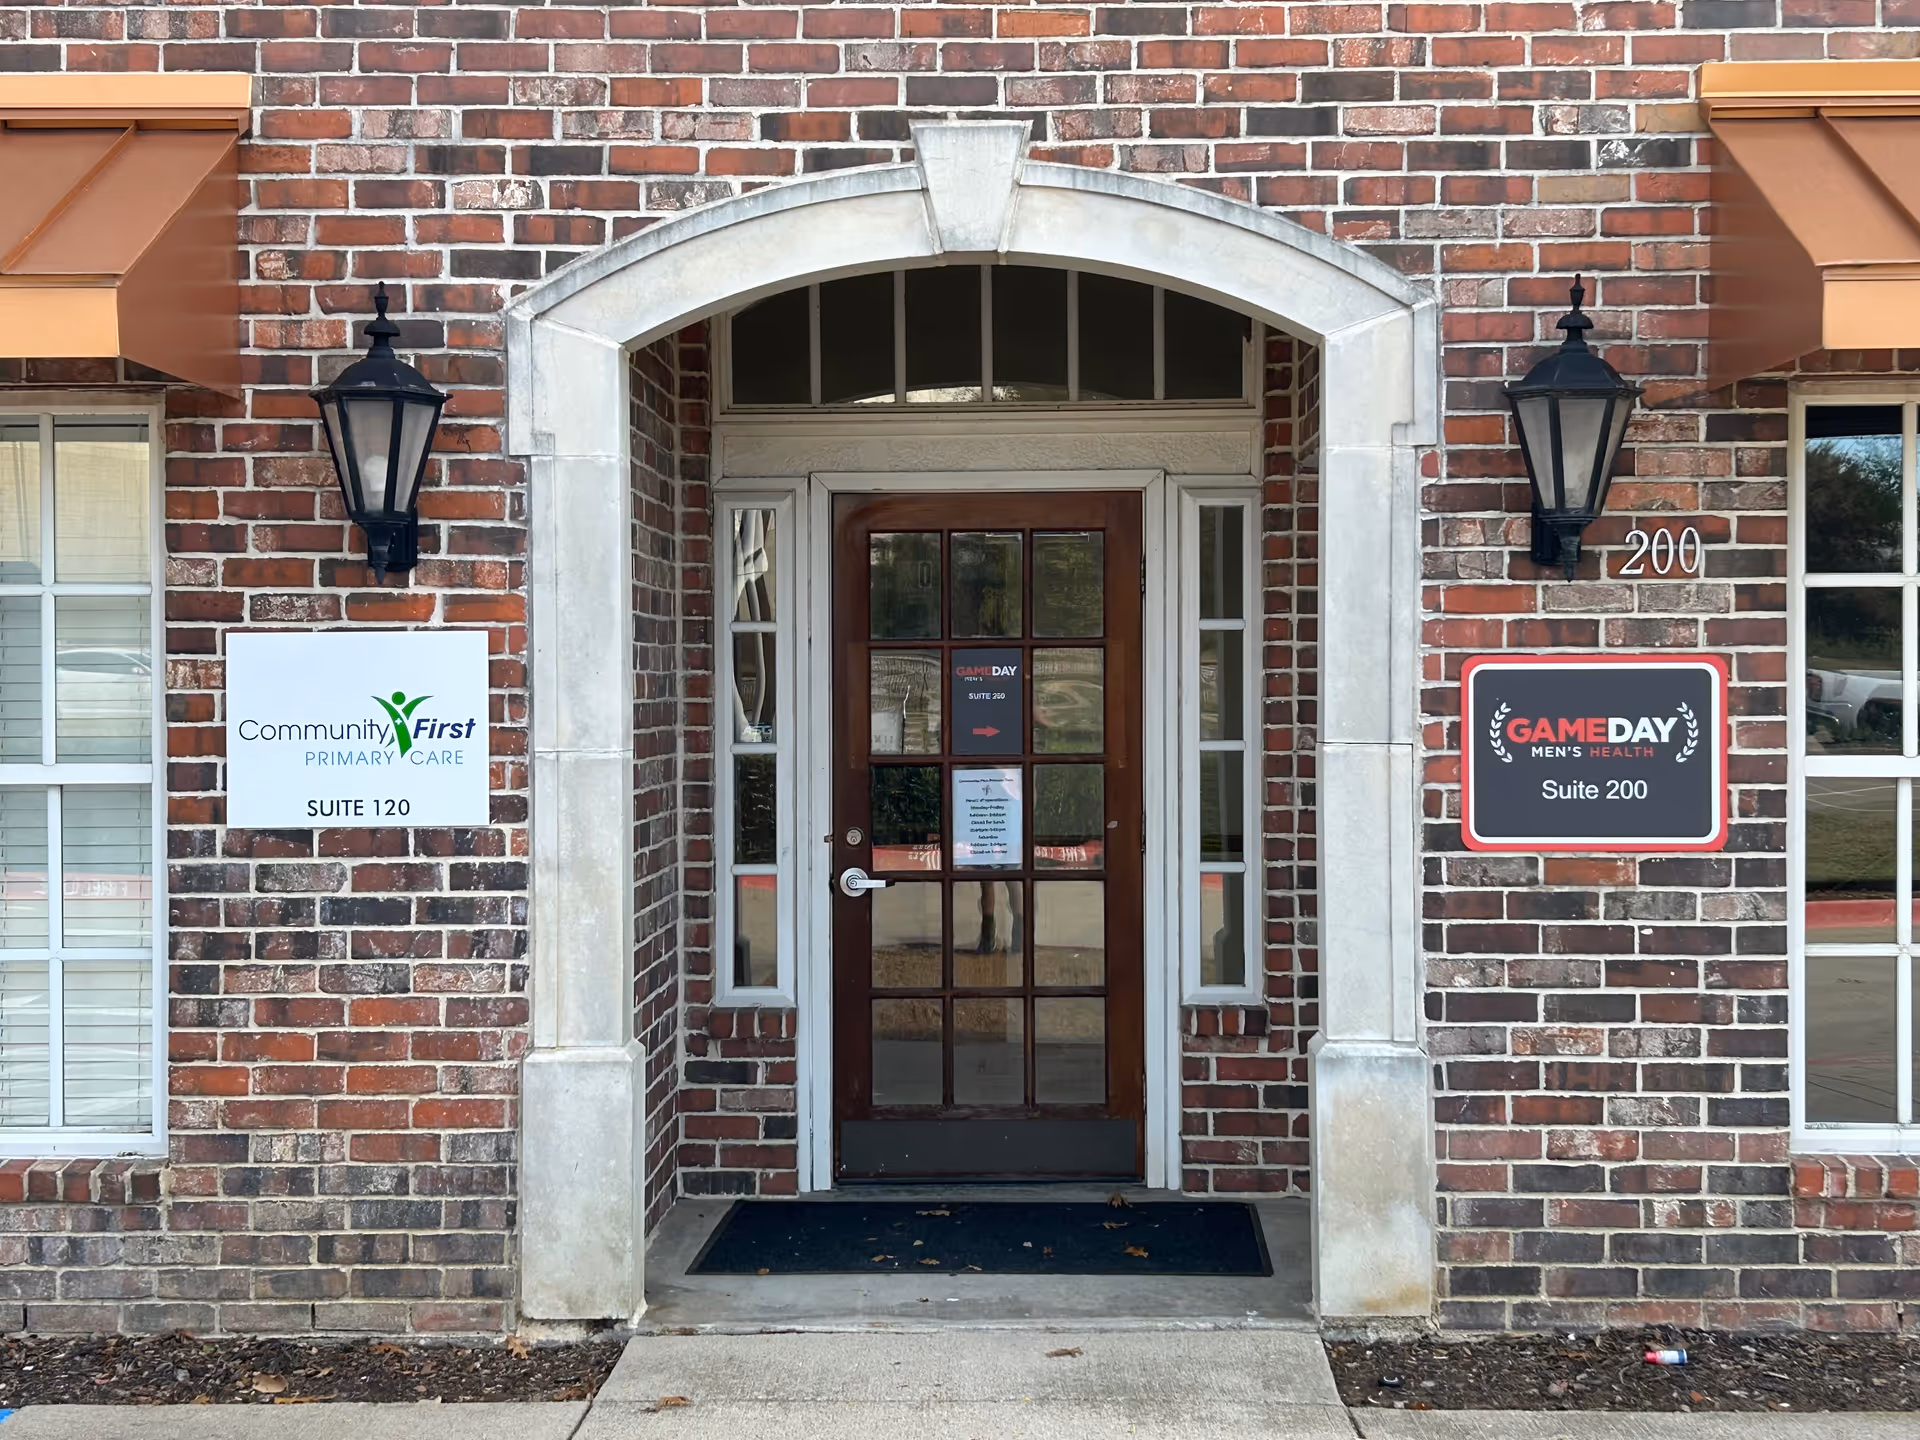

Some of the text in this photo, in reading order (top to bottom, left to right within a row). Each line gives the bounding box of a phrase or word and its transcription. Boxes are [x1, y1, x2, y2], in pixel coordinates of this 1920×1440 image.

[1619, 526, 1701, 576] 200
[955, 665, 1018, 676] GAMEDAY
[968, 692, 991, 700] SUITE
[239, 718, 477, 745] Community First
[1506, 716, 1678, 743] GAMEDAY
[305, 750, 464, 766] PRIMARY CARE
[1531, 746, 1654, 758] MEN'S HEALTH
[1542, 779, 1648, 800] Suite 200
[307, 799, 411, 817] SUITE 120
